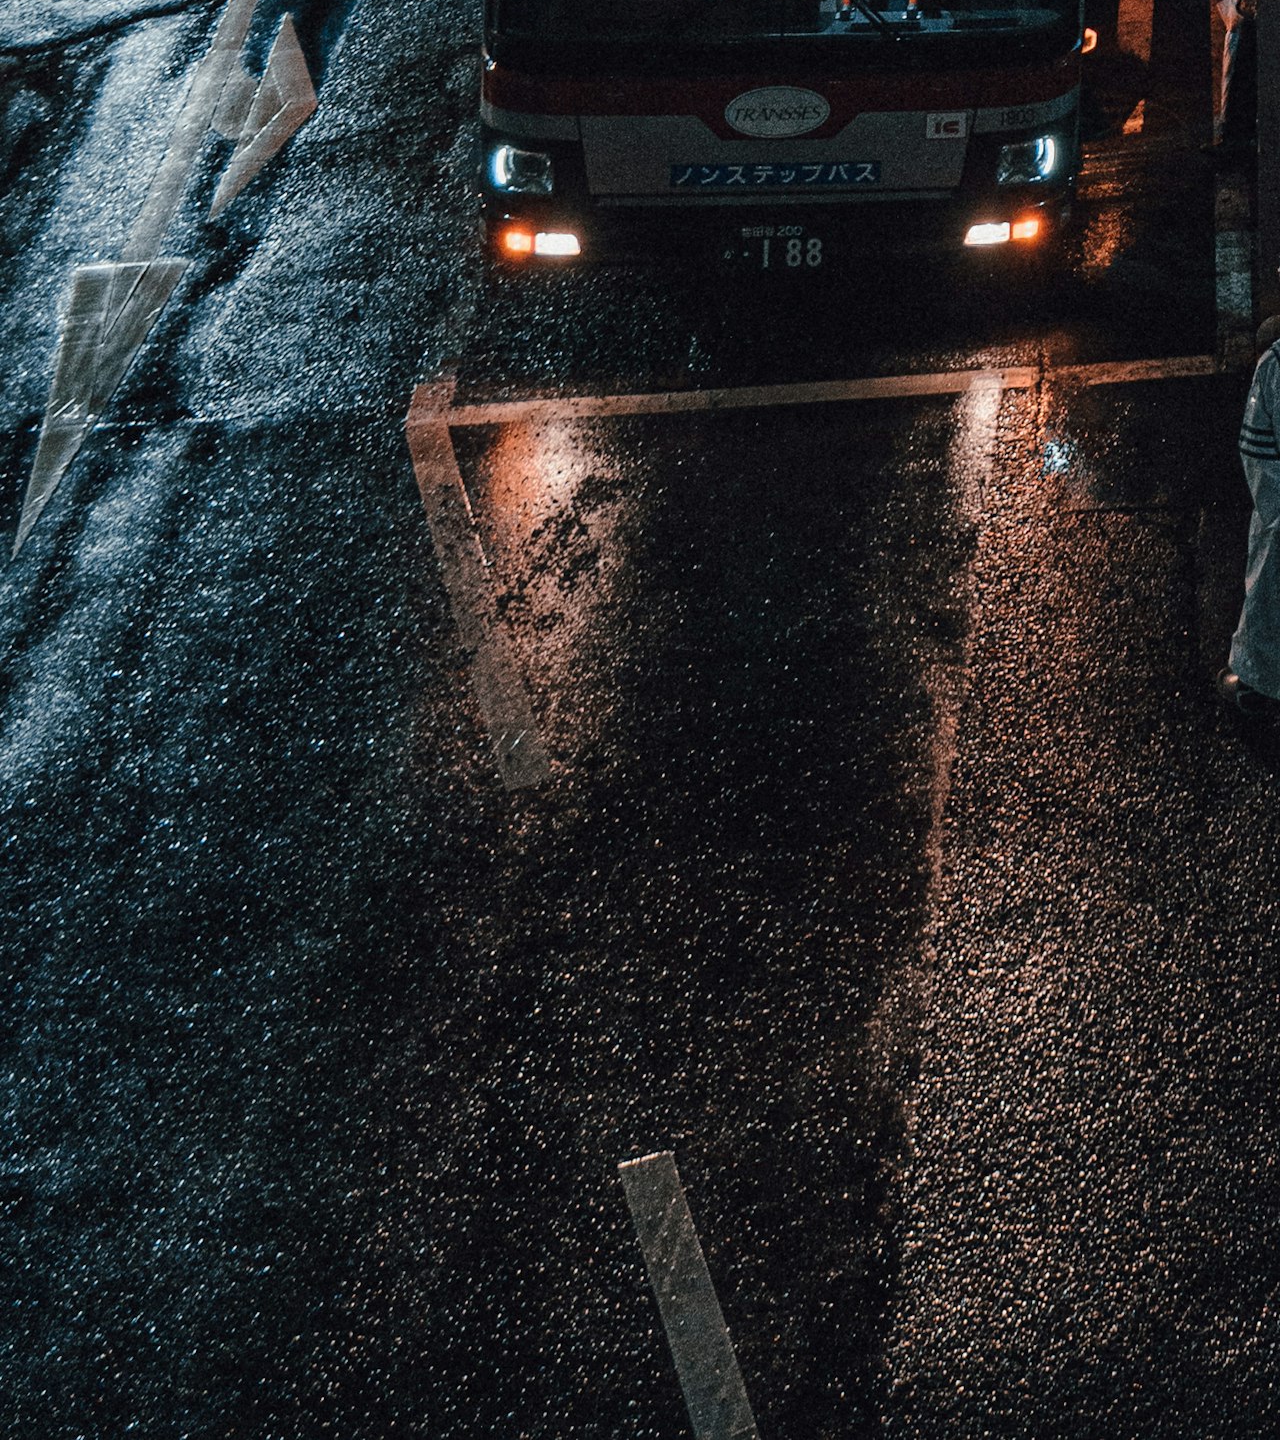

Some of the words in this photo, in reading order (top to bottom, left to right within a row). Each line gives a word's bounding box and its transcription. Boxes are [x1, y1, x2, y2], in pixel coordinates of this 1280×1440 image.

[734, 104, 822, 123] TRANSSES
[676, 162, 879, 184] ノンステップバス
